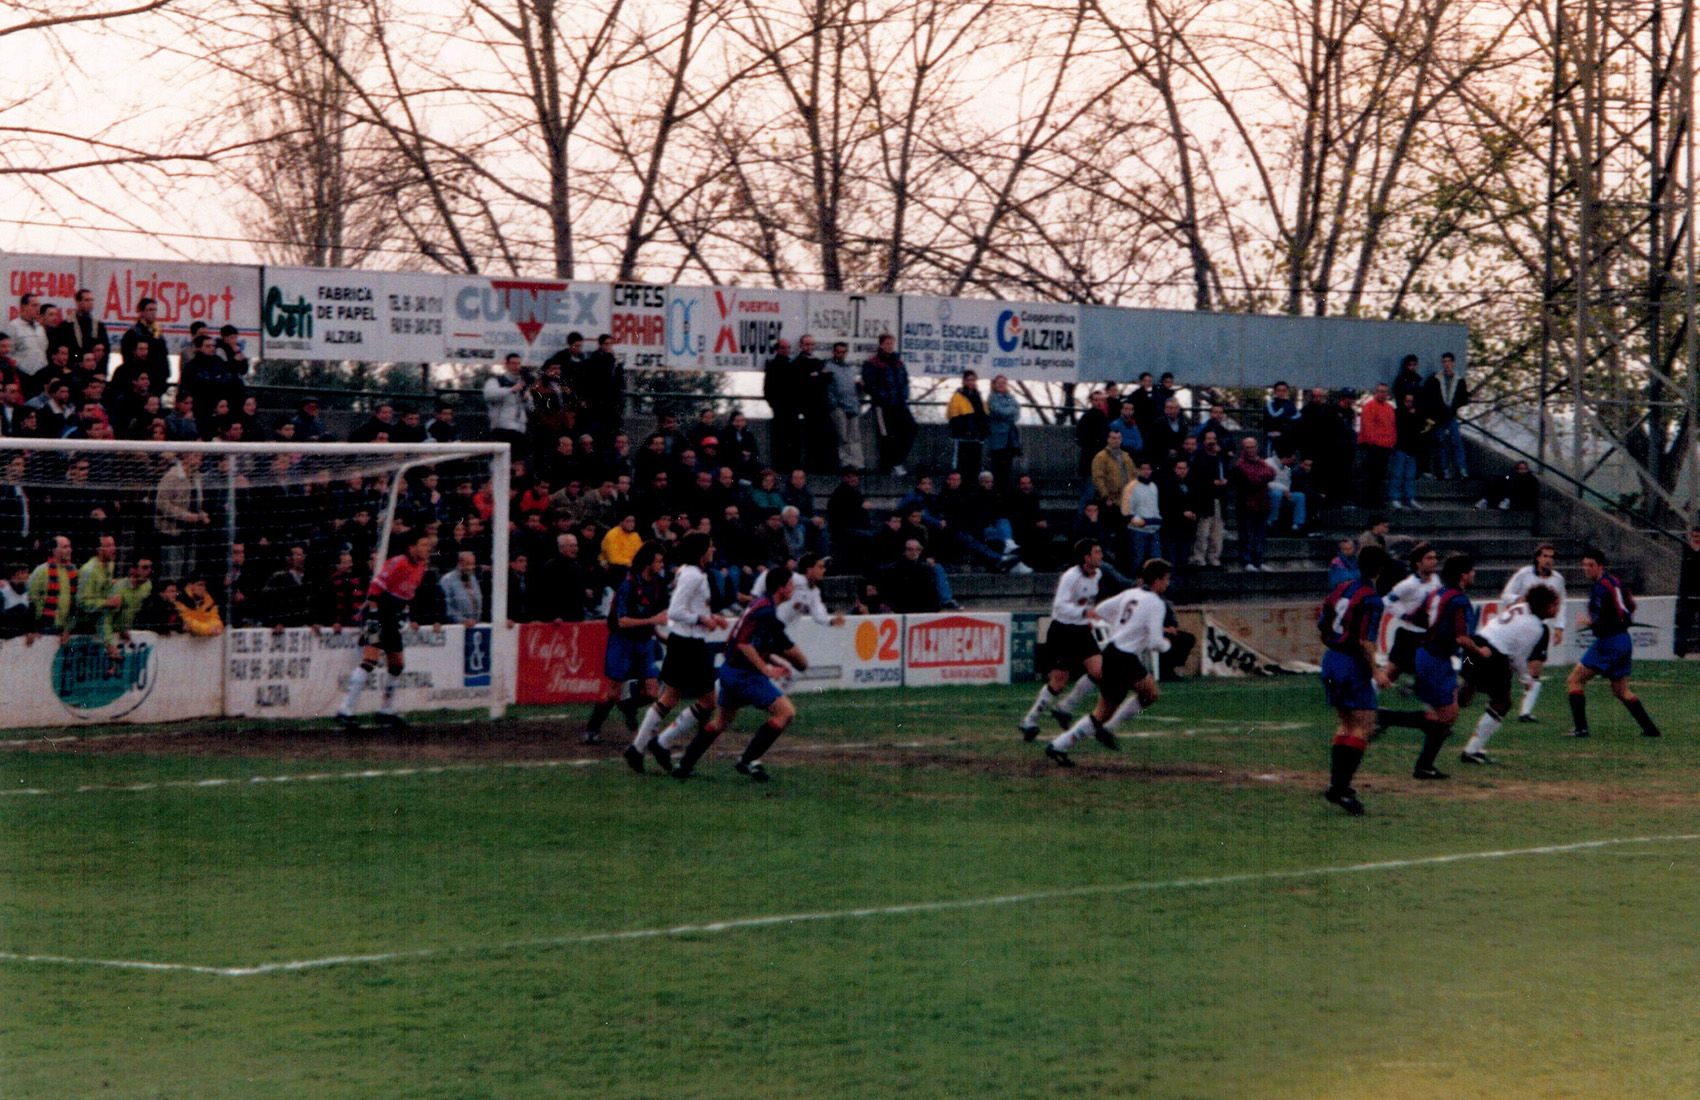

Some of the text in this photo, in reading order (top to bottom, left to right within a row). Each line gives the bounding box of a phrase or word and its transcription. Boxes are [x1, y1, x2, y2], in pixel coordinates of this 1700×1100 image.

[318, 286, 373, 302] FABRICA
[612, 284, 664, 308] CAFES
[316, 305, 377, 321] DE PAPEL
[738, 300, 780, 314] PUERTAS
[324, 330, 363, 345] ALZIRA
[611, 313, 664, 346] BAHIA
[904, 322, 932, 337] AUTO
[941, 324, 989, 340] ESCUELA
[1021, 328, 1076, 351] ALZIRA
